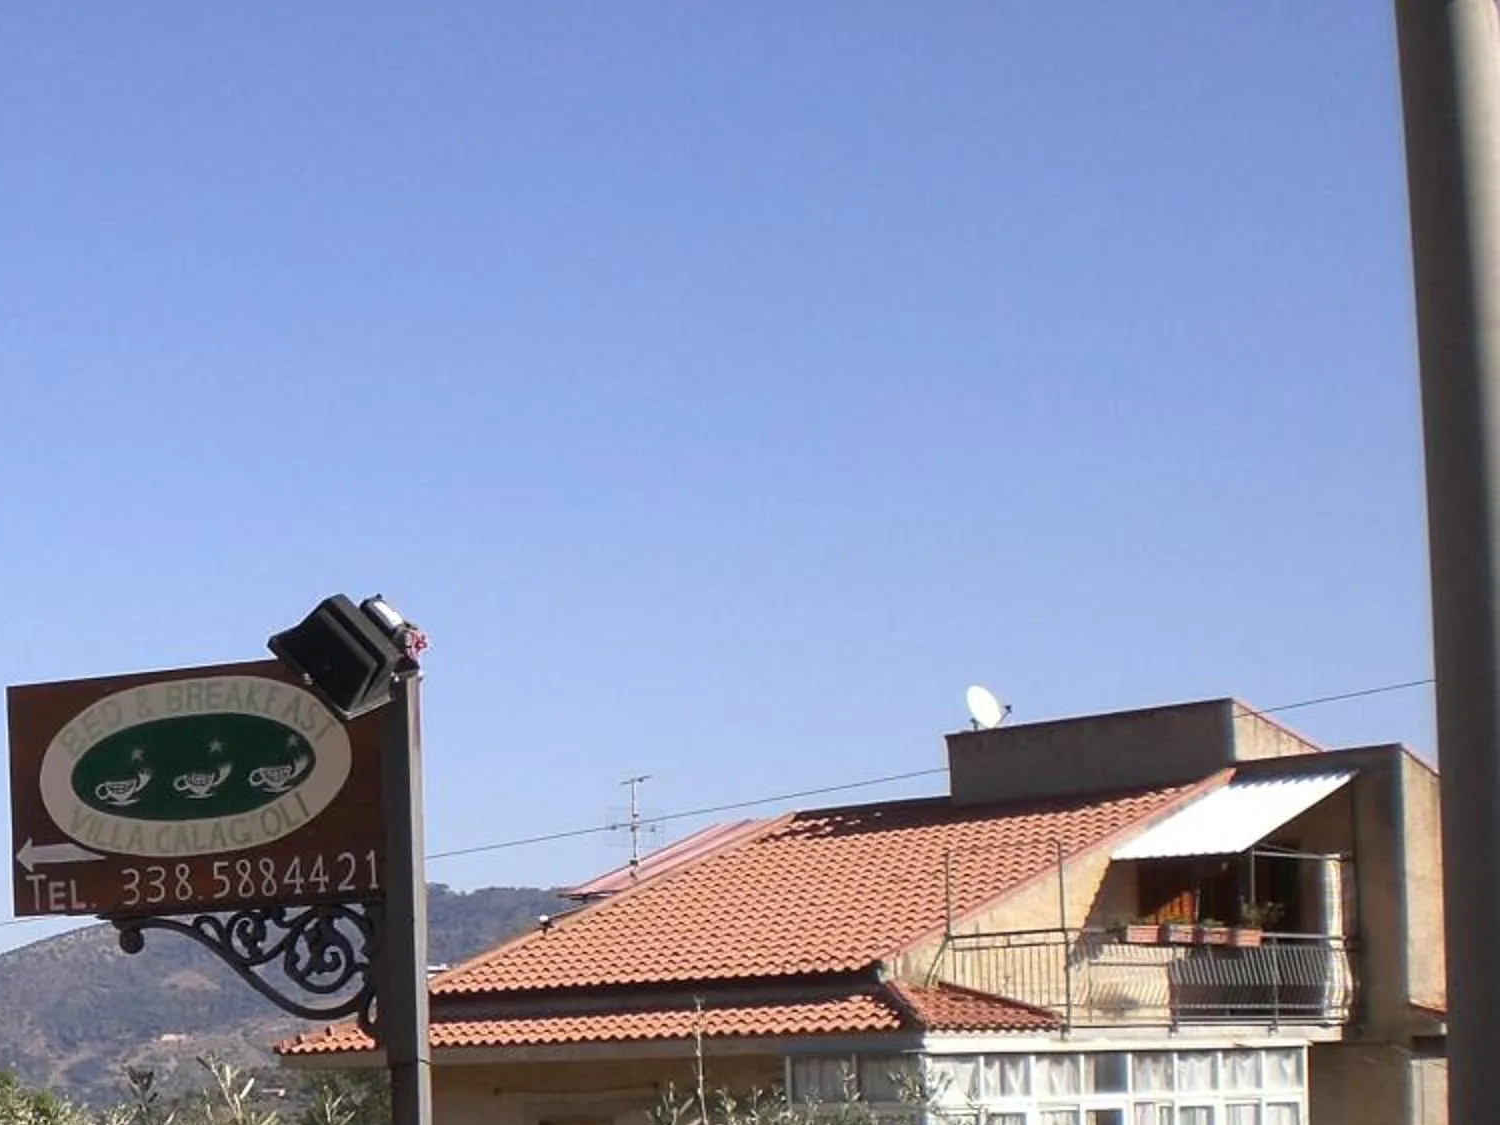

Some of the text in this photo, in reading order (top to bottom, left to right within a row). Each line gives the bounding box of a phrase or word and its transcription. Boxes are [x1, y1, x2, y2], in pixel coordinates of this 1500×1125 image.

[61, 683, 337, 755] BED & BREAKFAST
[70, 805, 147, 853] VILLA
[120, 849, 381, 907] 338.5884421
